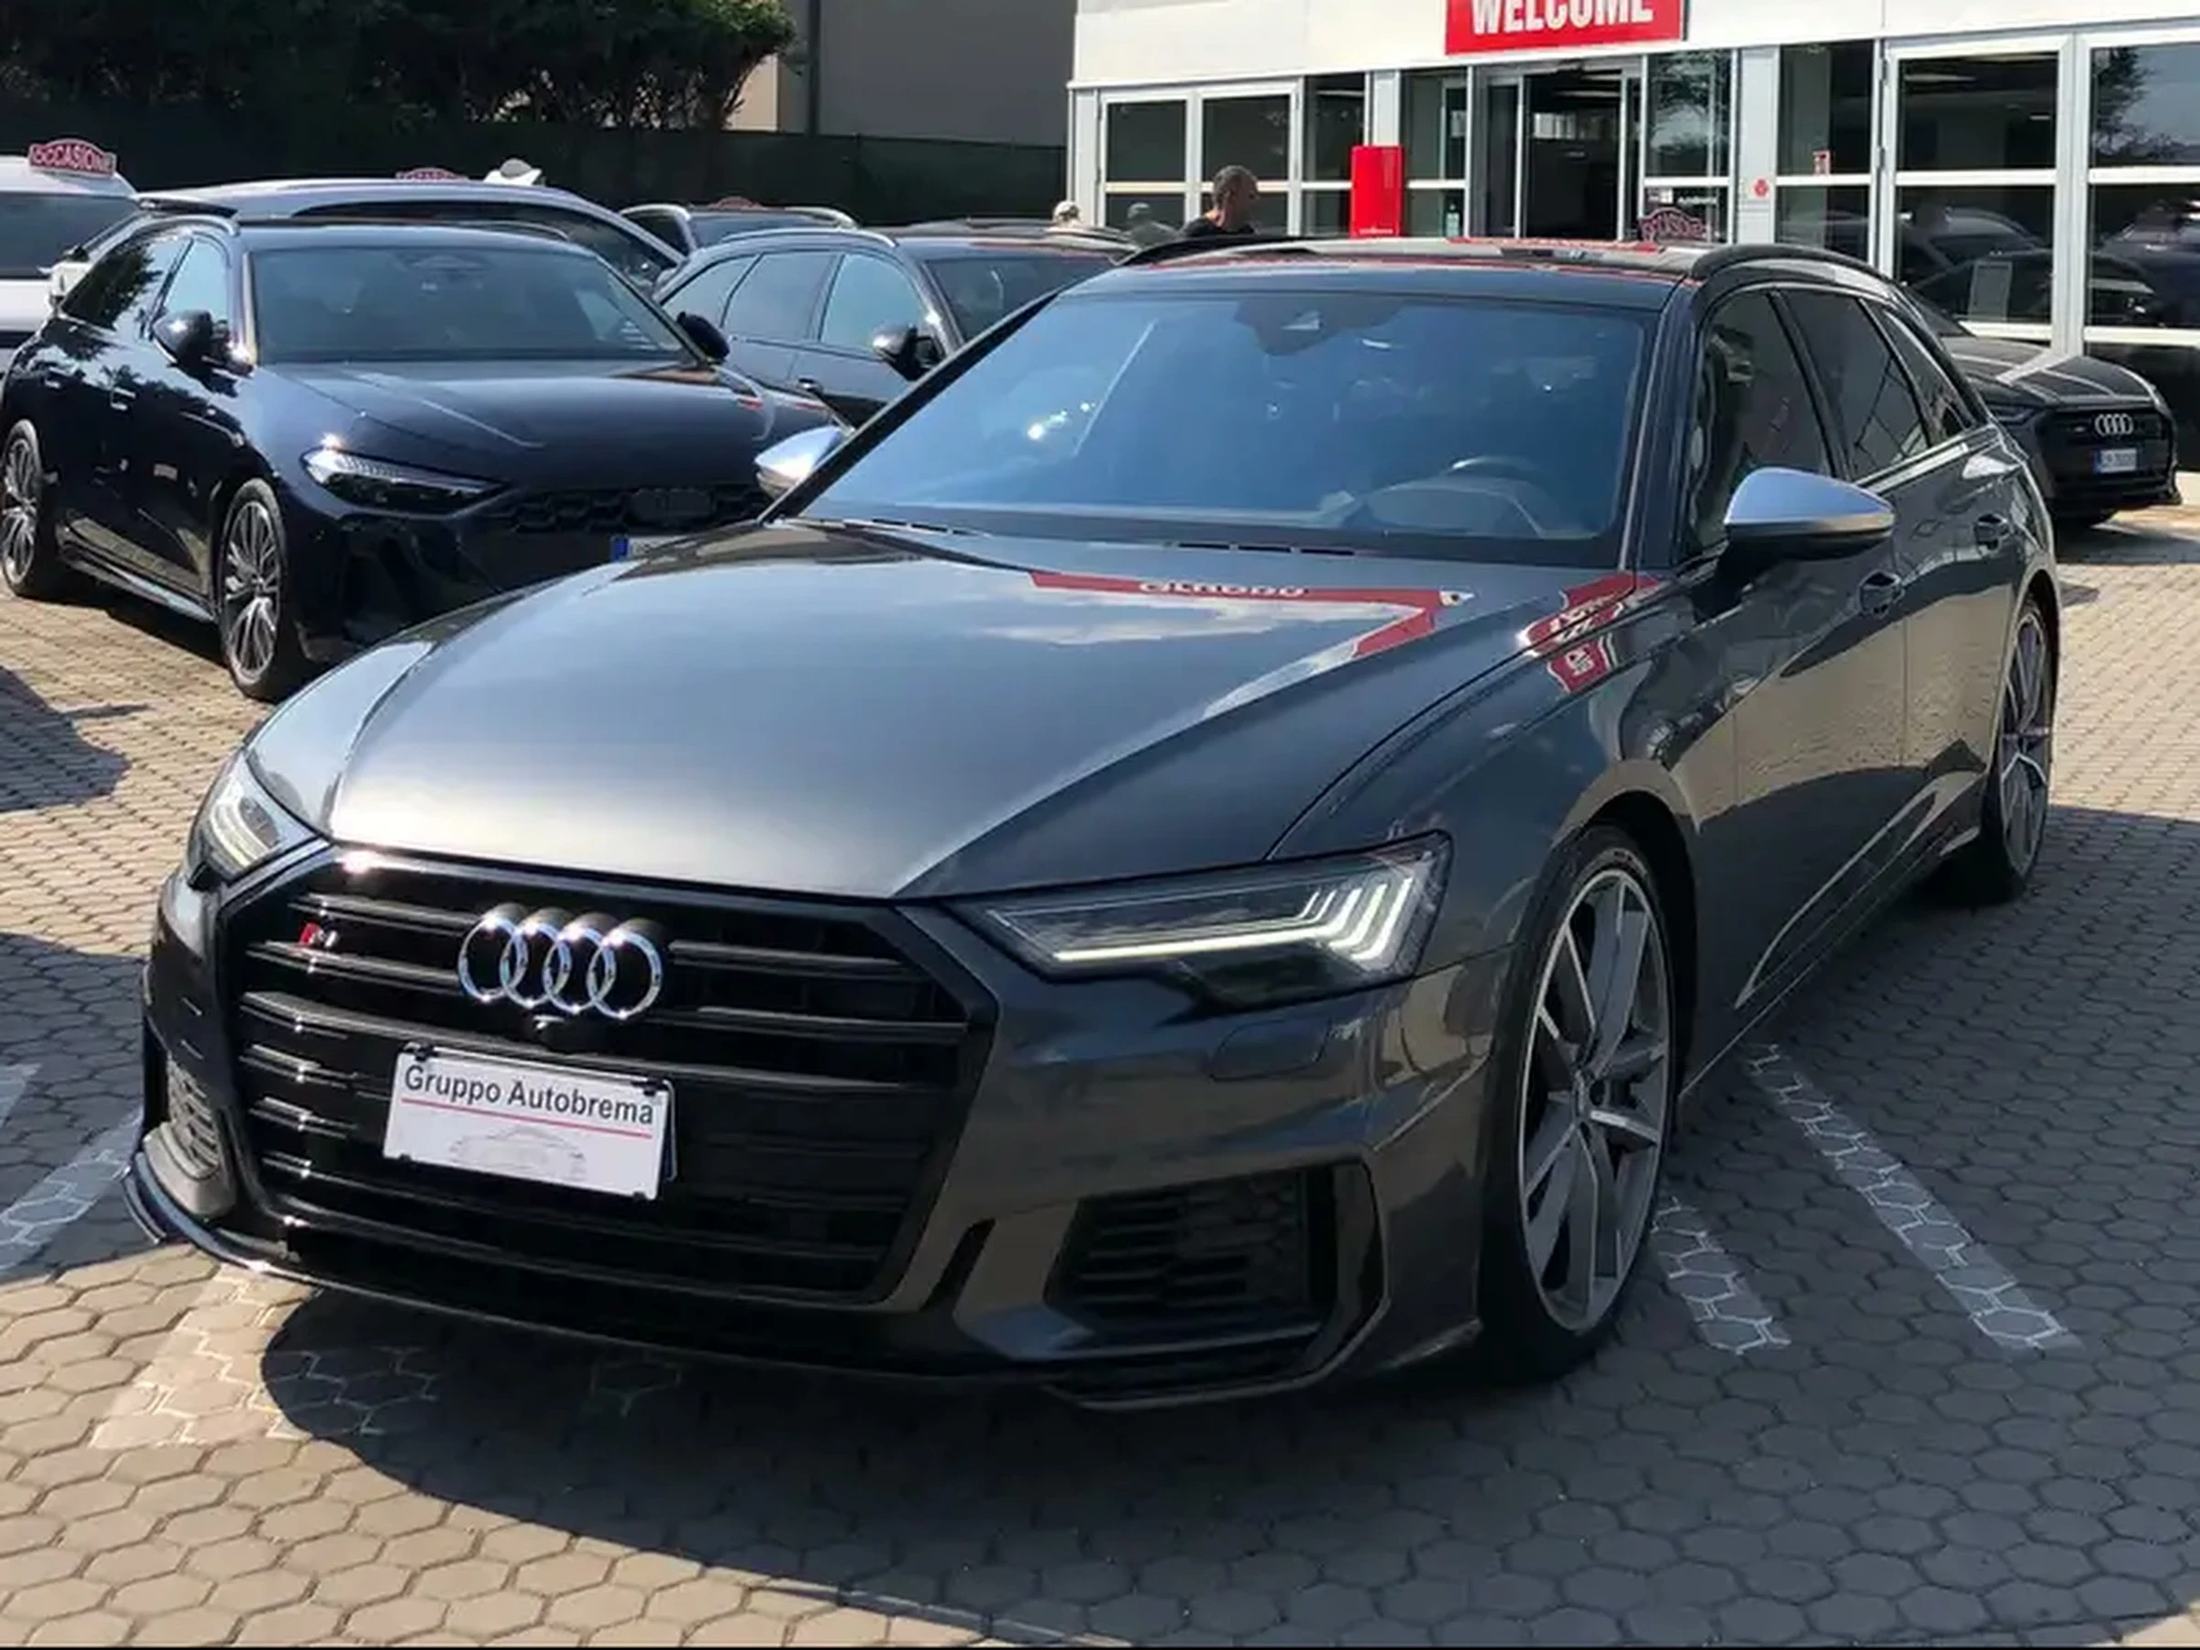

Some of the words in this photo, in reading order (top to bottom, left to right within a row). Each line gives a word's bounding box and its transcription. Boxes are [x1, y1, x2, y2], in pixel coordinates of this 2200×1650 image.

[1472, 0, 1653, 35] WELCOME
[404, 1064, 501, 1105] Gruppo
[508, 1080, 653, 1125] Autobrema
